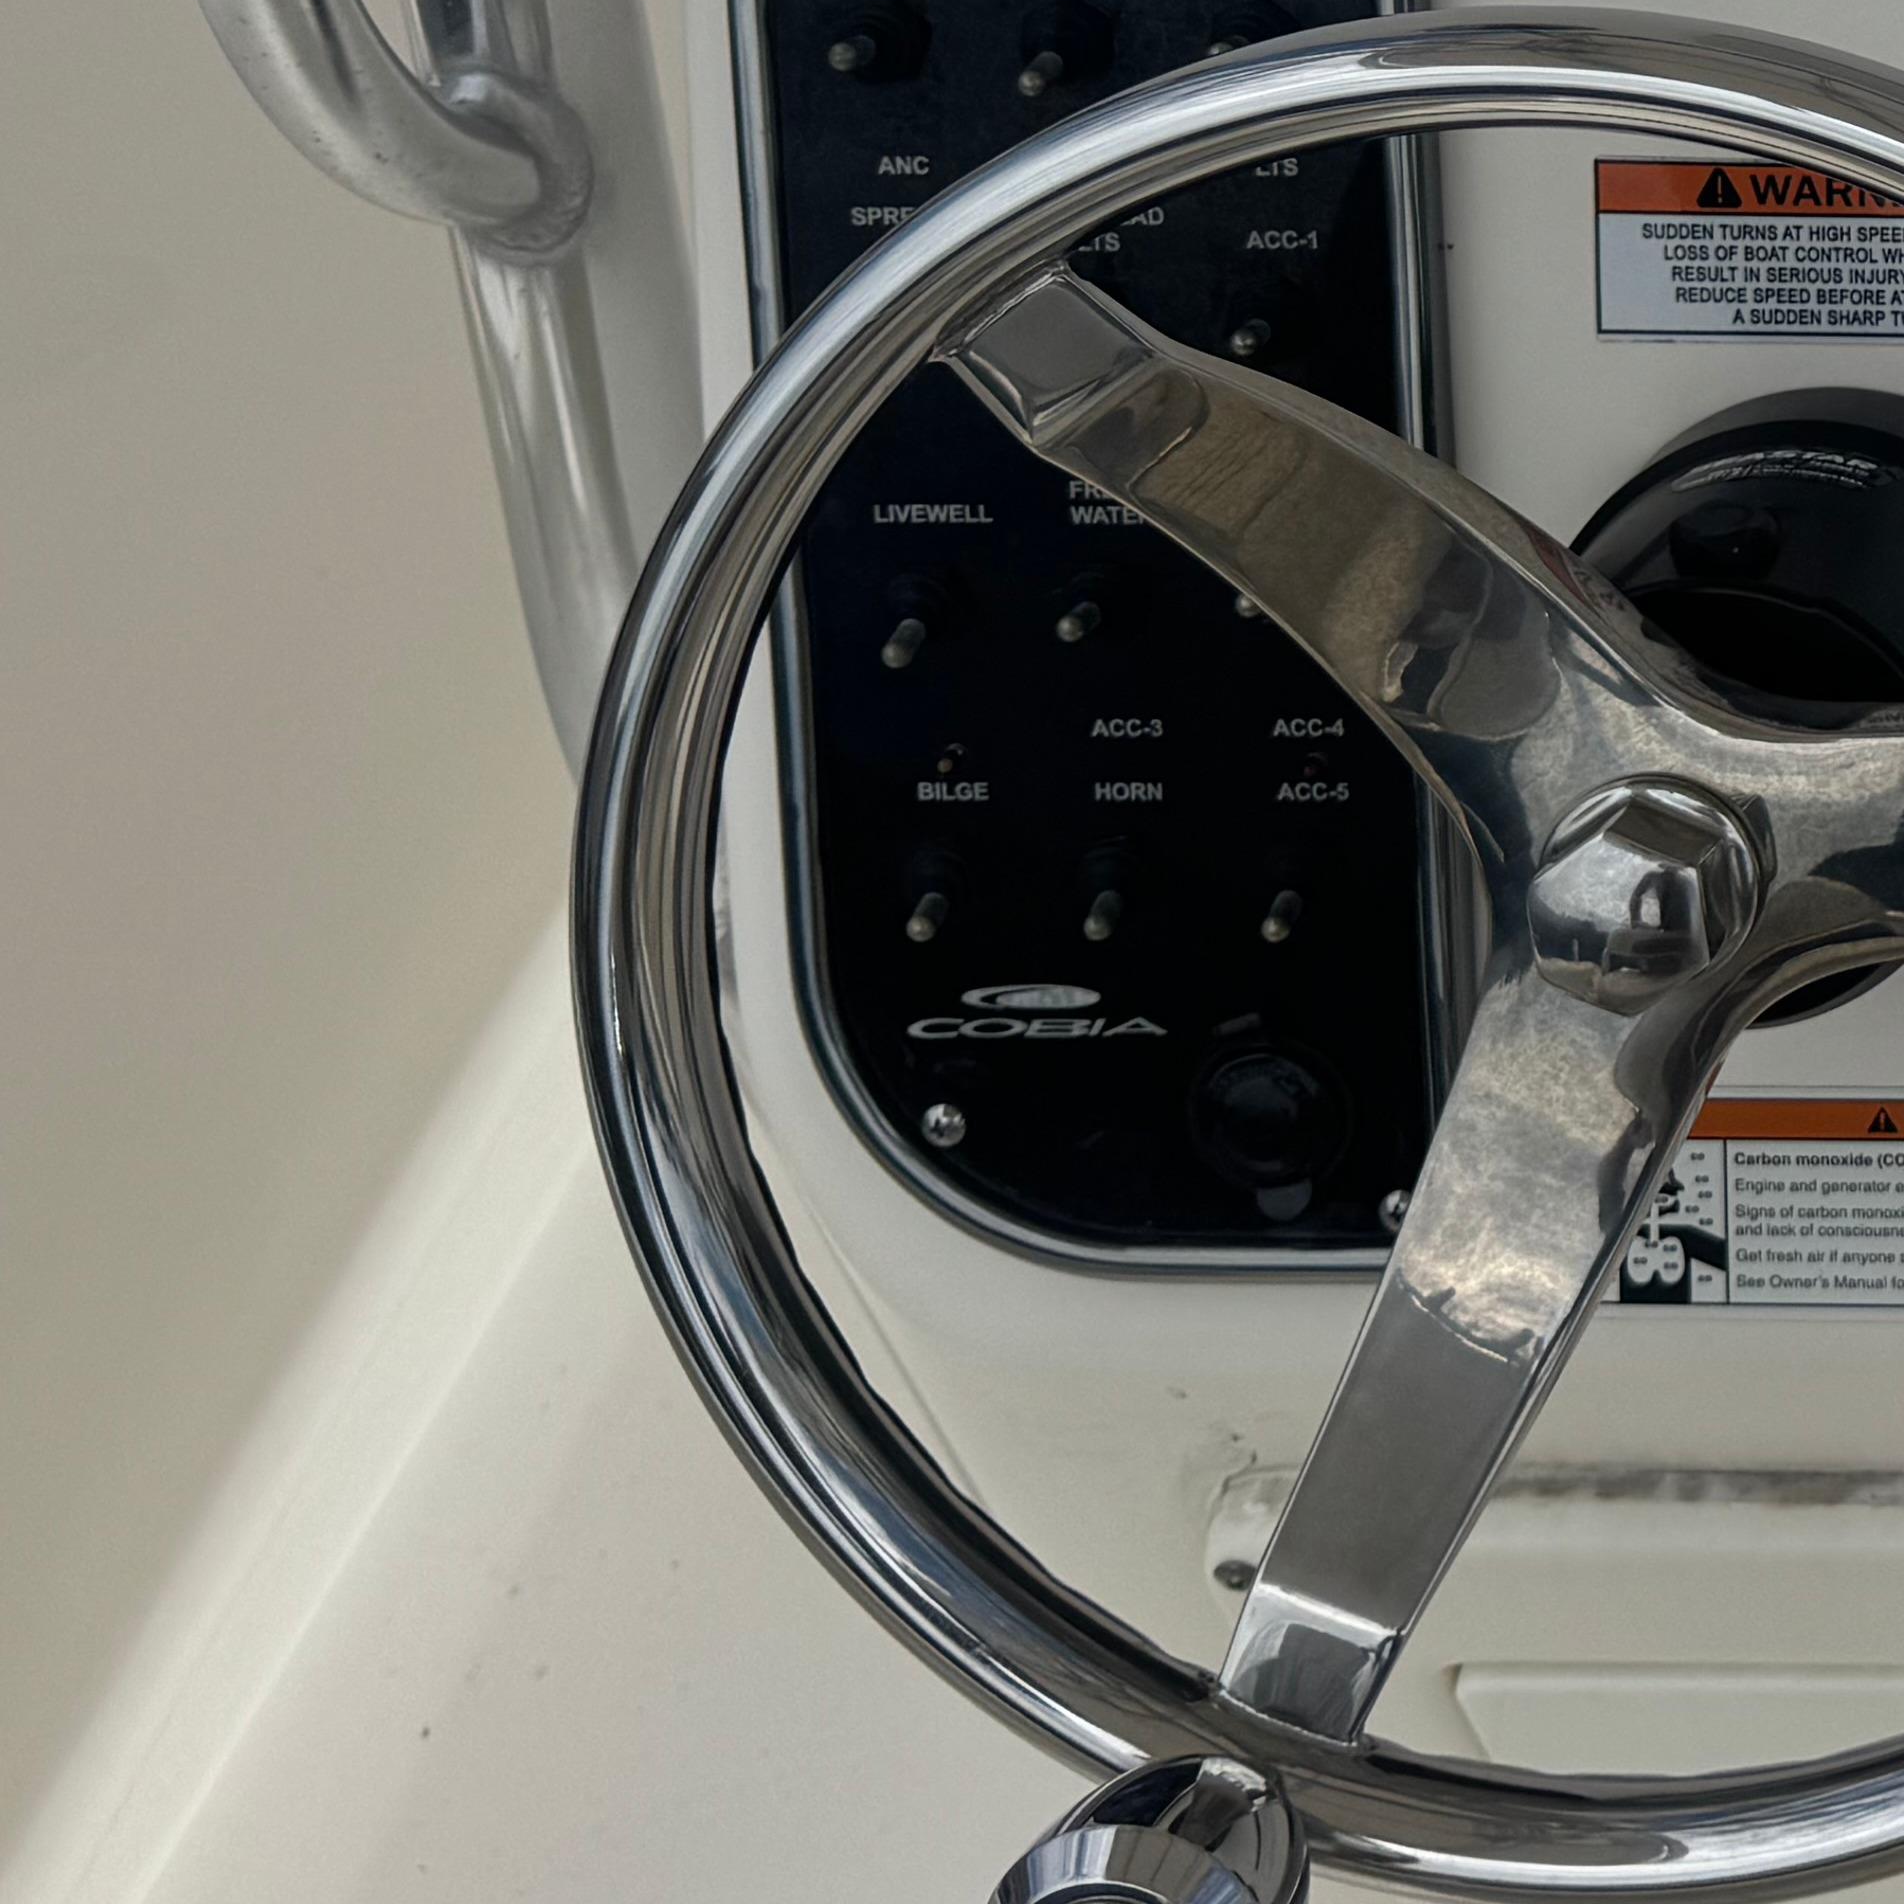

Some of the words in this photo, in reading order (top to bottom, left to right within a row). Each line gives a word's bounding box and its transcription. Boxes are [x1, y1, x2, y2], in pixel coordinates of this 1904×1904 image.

[878, 156, 930, 176] ANC
[1247, 231, 1318, 251] ACC-1
[1642, 222, 1713, 240] SUDDEN
[1718, 223, 1777, 241] TURNS
[1781, 224, 1803, 241] AT
[1808, 225, 1851, 242] HIGH
[1663, 244, 1709, 261] LOSS
[1713, 244, 1738, 261] OF
[1743, 245, 1789, 262] BOAT
[1793, 245, 1878, 264] CONTROL
[1671, 265, 1738, 283] RESULT
[1743, 266, 1760, 283] IN
[1765, 266, 1843, 284] SERIOUS
[1675, 286, 1747, 303] REDUCE
[1752, 287, 1811, 304] SPEED
[1816, 288, 1886, 305] BEFORE
[1732, 308, 1745, 324] A
[1750, 308, 1821, 325] SUDDEN
[1827, 308, 1885, 326] SHARP
[875, 504, 993, 524] LIVEWELL
[1092, 718, 1163, 738] ACC-3
[1273, 718, 1345, 738] ACC-4
[918, 782, 990, 802] BILGE
[1095, 782, 1164, 802] HORN
[1277, 782, 1350, 802] ACC-5
[907, 1017, 1168, 1039] COBIA
[1733, 1151, 1791, 1166] Carbon
[1795, 1152, 1873, 1167] monoxide
[1734, 1177, 1785, 1196] Engine
[1789, 1179, 1817, 1192] and
[1821, 1180, 1891, 1196] generator
[1734, 1203, 1776, 1221] Signs
[1779, 1204, 1793, 1218] of
[1797, 1205, 1847, 1219] carbon
[1734, 1222, 1763, 1236] and
[1766, 1223, 1796, 1237] lack
[1799, 1222, 1813, 1236] of
[1735, 1248, 1762, 1262] Get
[1765, 1248, 1802, 1262] fresh
[1806, 1250, 1824, 1263] air
[1829, 1249, 1838, 1262] if
[1841, 1252, 1895, 1266] anyone
[1736, 1274, 1765, 1288] See
[1833, 1275, 1887, 1289] Manual
